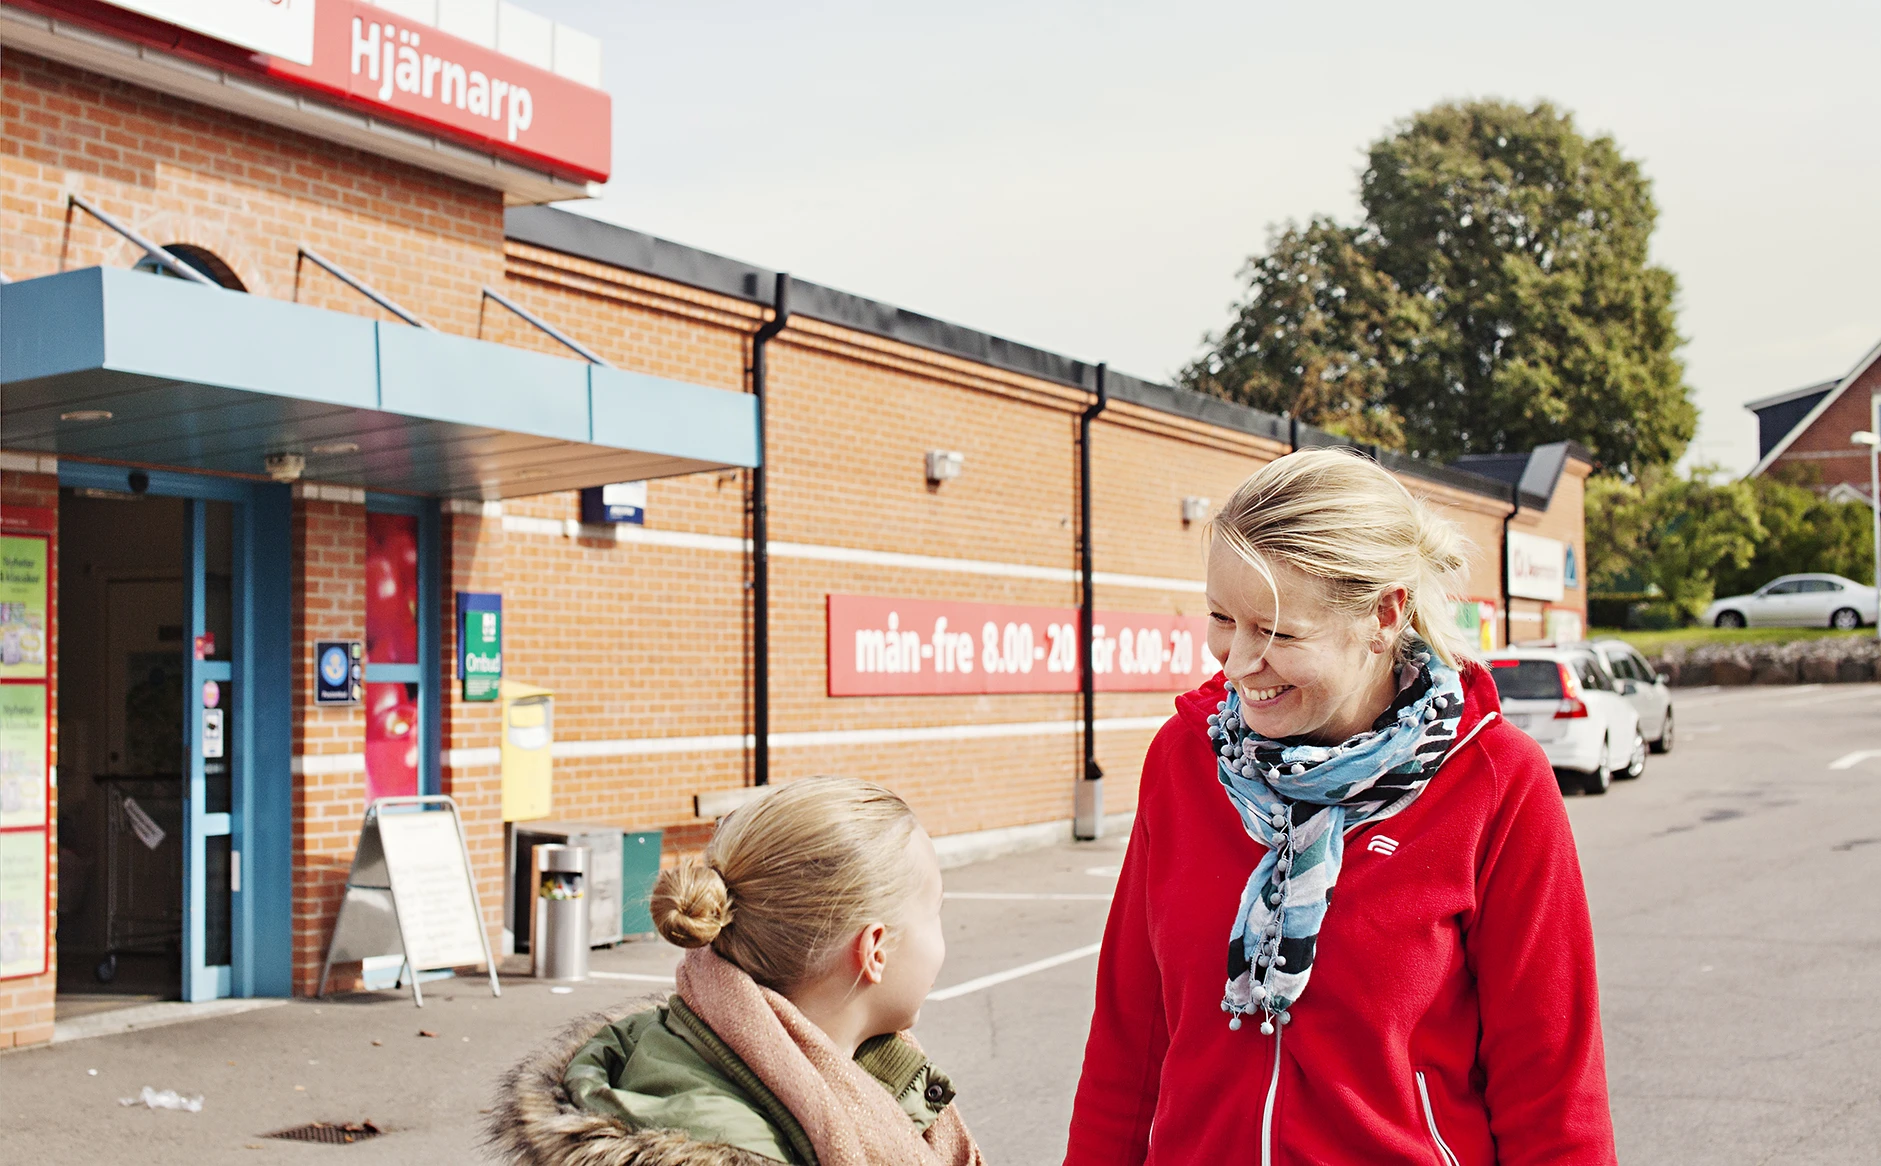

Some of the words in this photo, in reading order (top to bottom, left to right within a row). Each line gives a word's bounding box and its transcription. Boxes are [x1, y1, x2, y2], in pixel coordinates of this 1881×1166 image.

[352, 18, 532, 141] Hjärnarp
[855, 611, 974, 673] mån-fre
[982, 621, 1076, 673] 8.00-20
[1091, 624, 1116, 674] ör
[1119, 627, 1192, 675] 8.00-20
